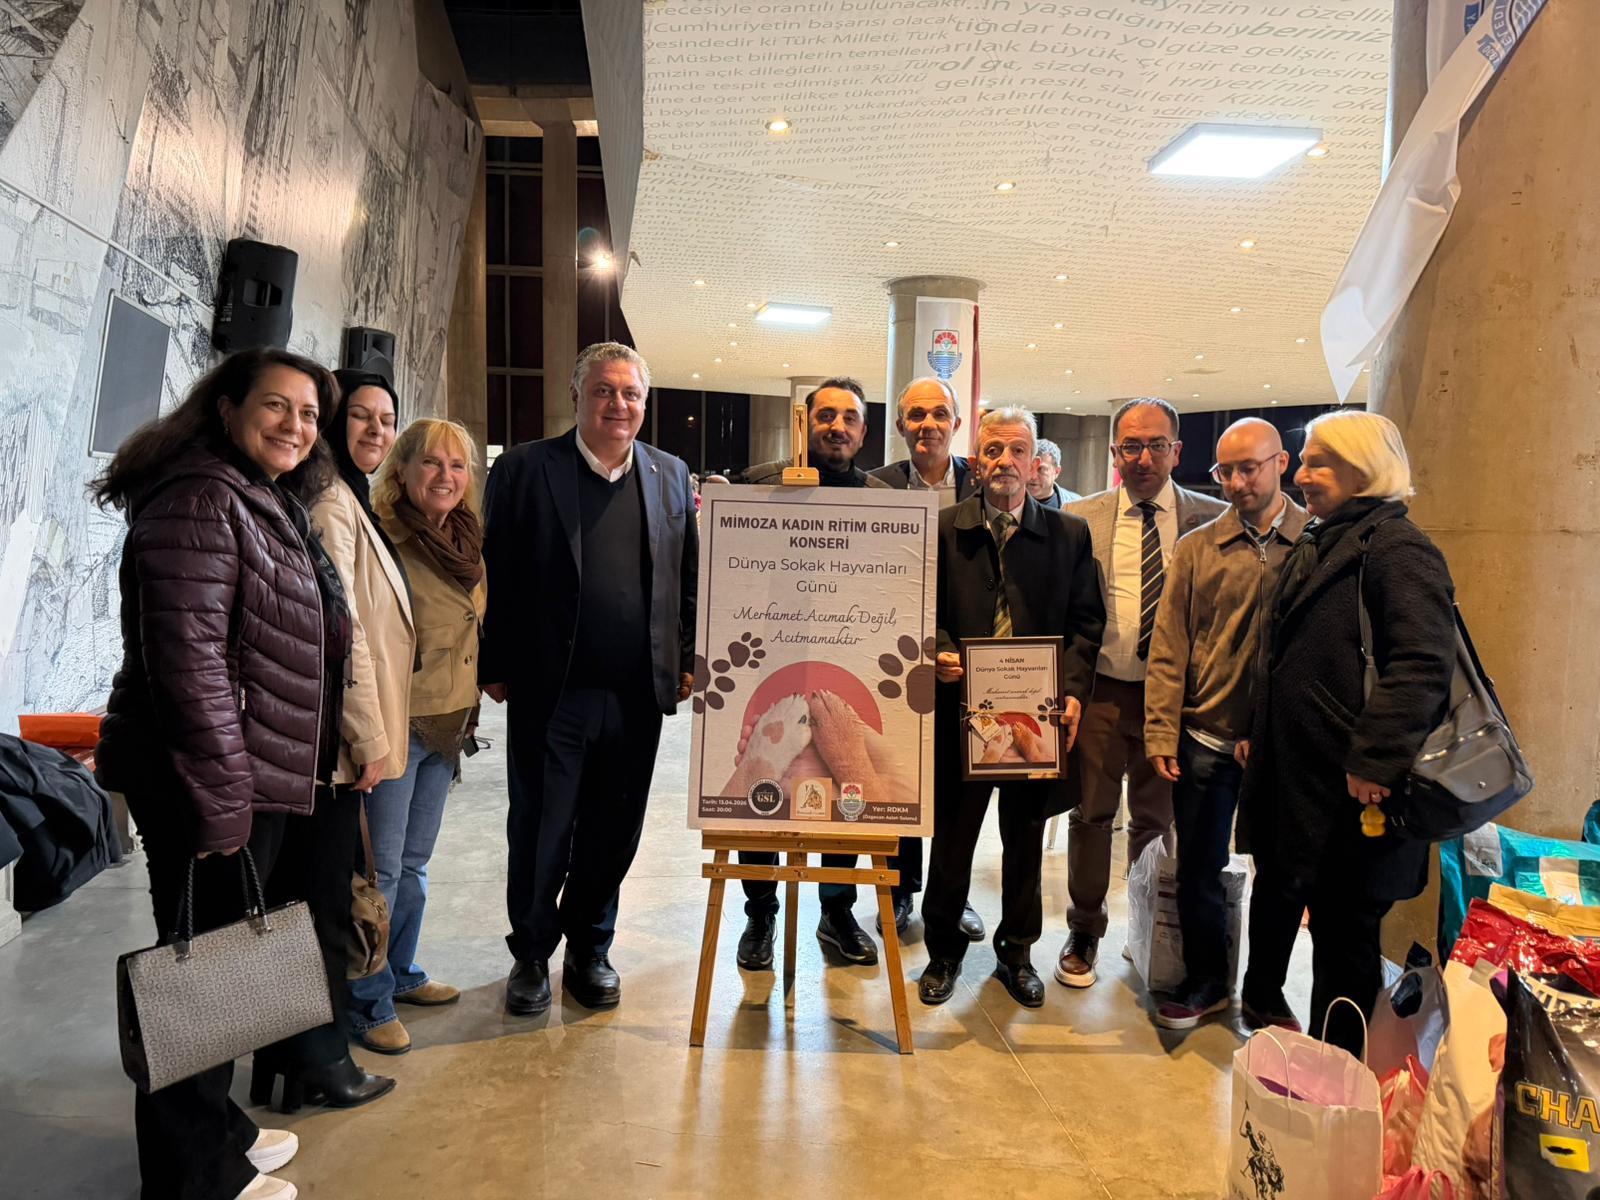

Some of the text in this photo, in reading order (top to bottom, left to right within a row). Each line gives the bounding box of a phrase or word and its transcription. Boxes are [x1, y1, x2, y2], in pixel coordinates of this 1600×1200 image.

[783, 35, 827, 46] Türk
[720, 514, 920, 535] MİMOZA KADIN RİTİM GRUBU
[789, 535, 850, 550] KONSERİ
[728, 556, 907, 575] Dünya Sokak Hayvanları
[796, 579, 838, 593] Günü
[733, 602, 803, 621] Merhamet
[804, 604, 860, 623] Acımak
[770, 626, 867, 645] Acıtmamaktır
